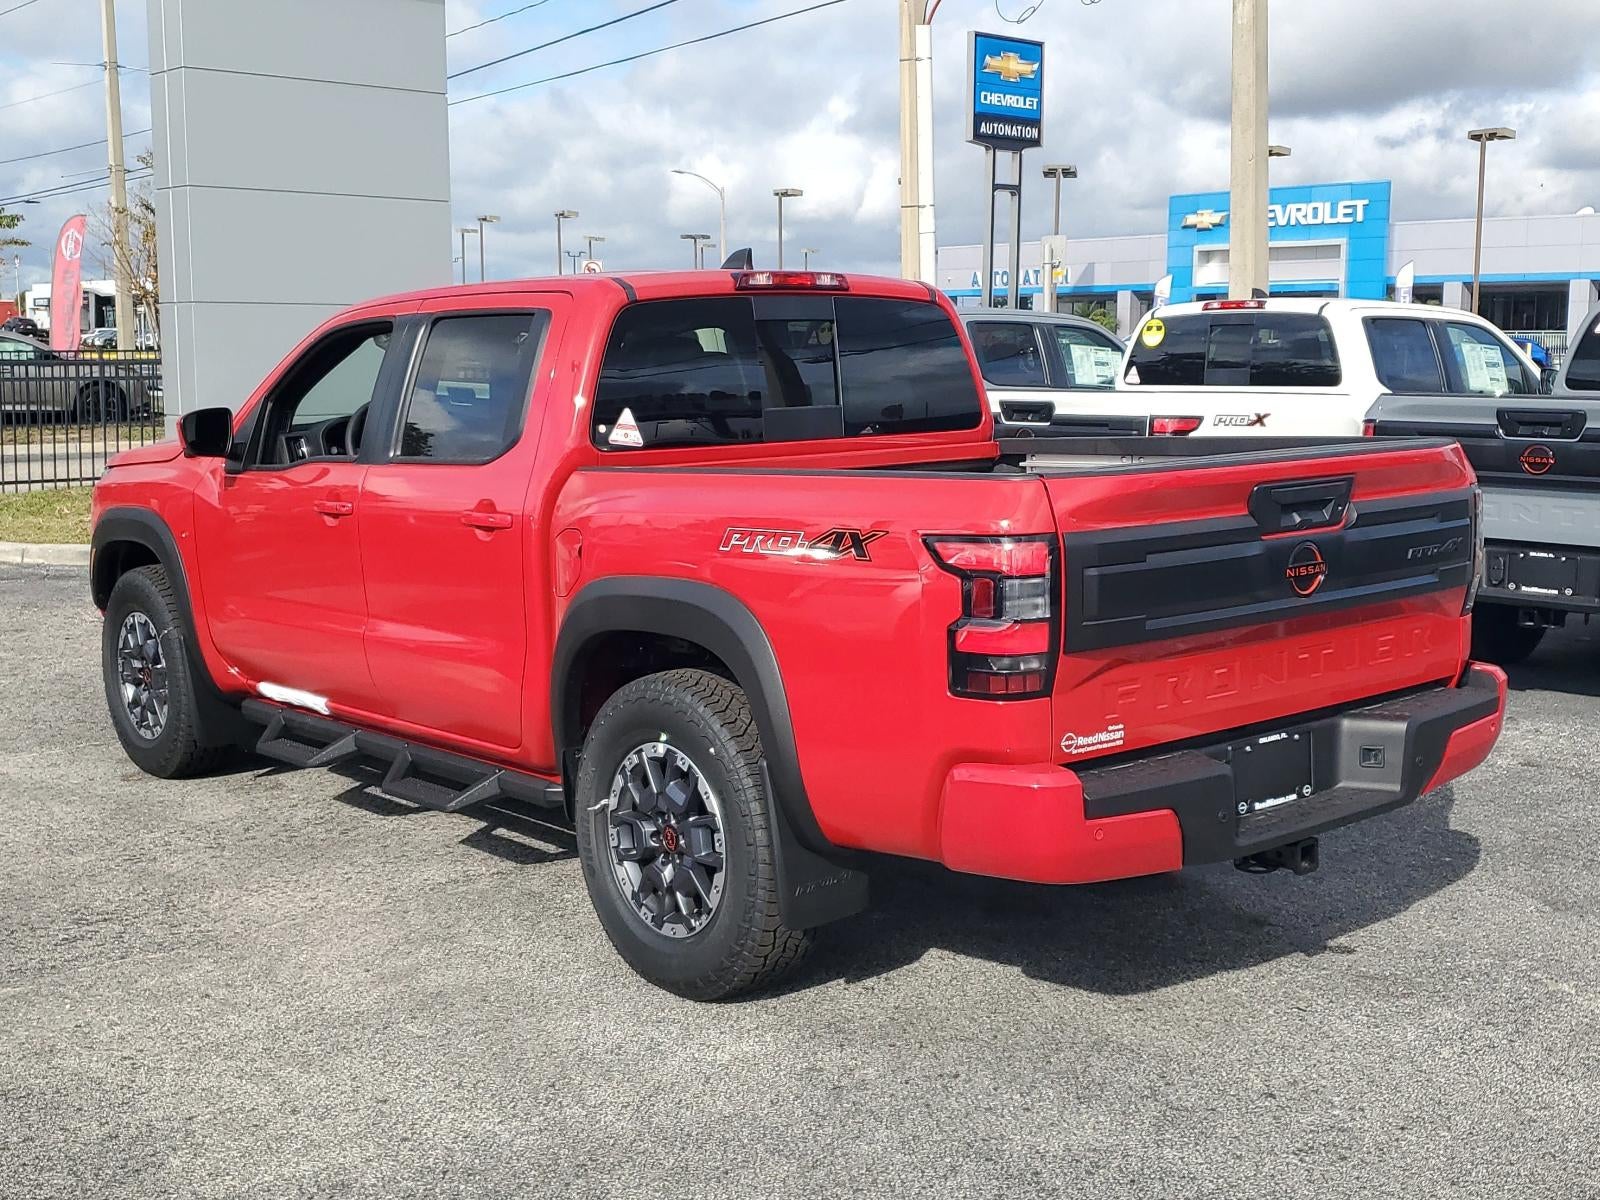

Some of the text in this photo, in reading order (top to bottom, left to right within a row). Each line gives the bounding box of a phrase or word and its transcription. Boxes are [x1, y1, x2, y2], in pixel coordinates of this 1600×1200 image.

[980, 91, 1039, 110] CHEVROLET
[980, 121, 1039, 139] AUTONATION
[1267, 198, 1369, 227] EVROLET
[1520, 455, 1556, 465] NISSAN
[719, 526, 889, 562] PRO-4X
[1286, 562, 1327, 578] NISSAN
[1102, 627, 1433, 719] FRONTIER
[1077, 730, 1124, 746] Reed Nissan
